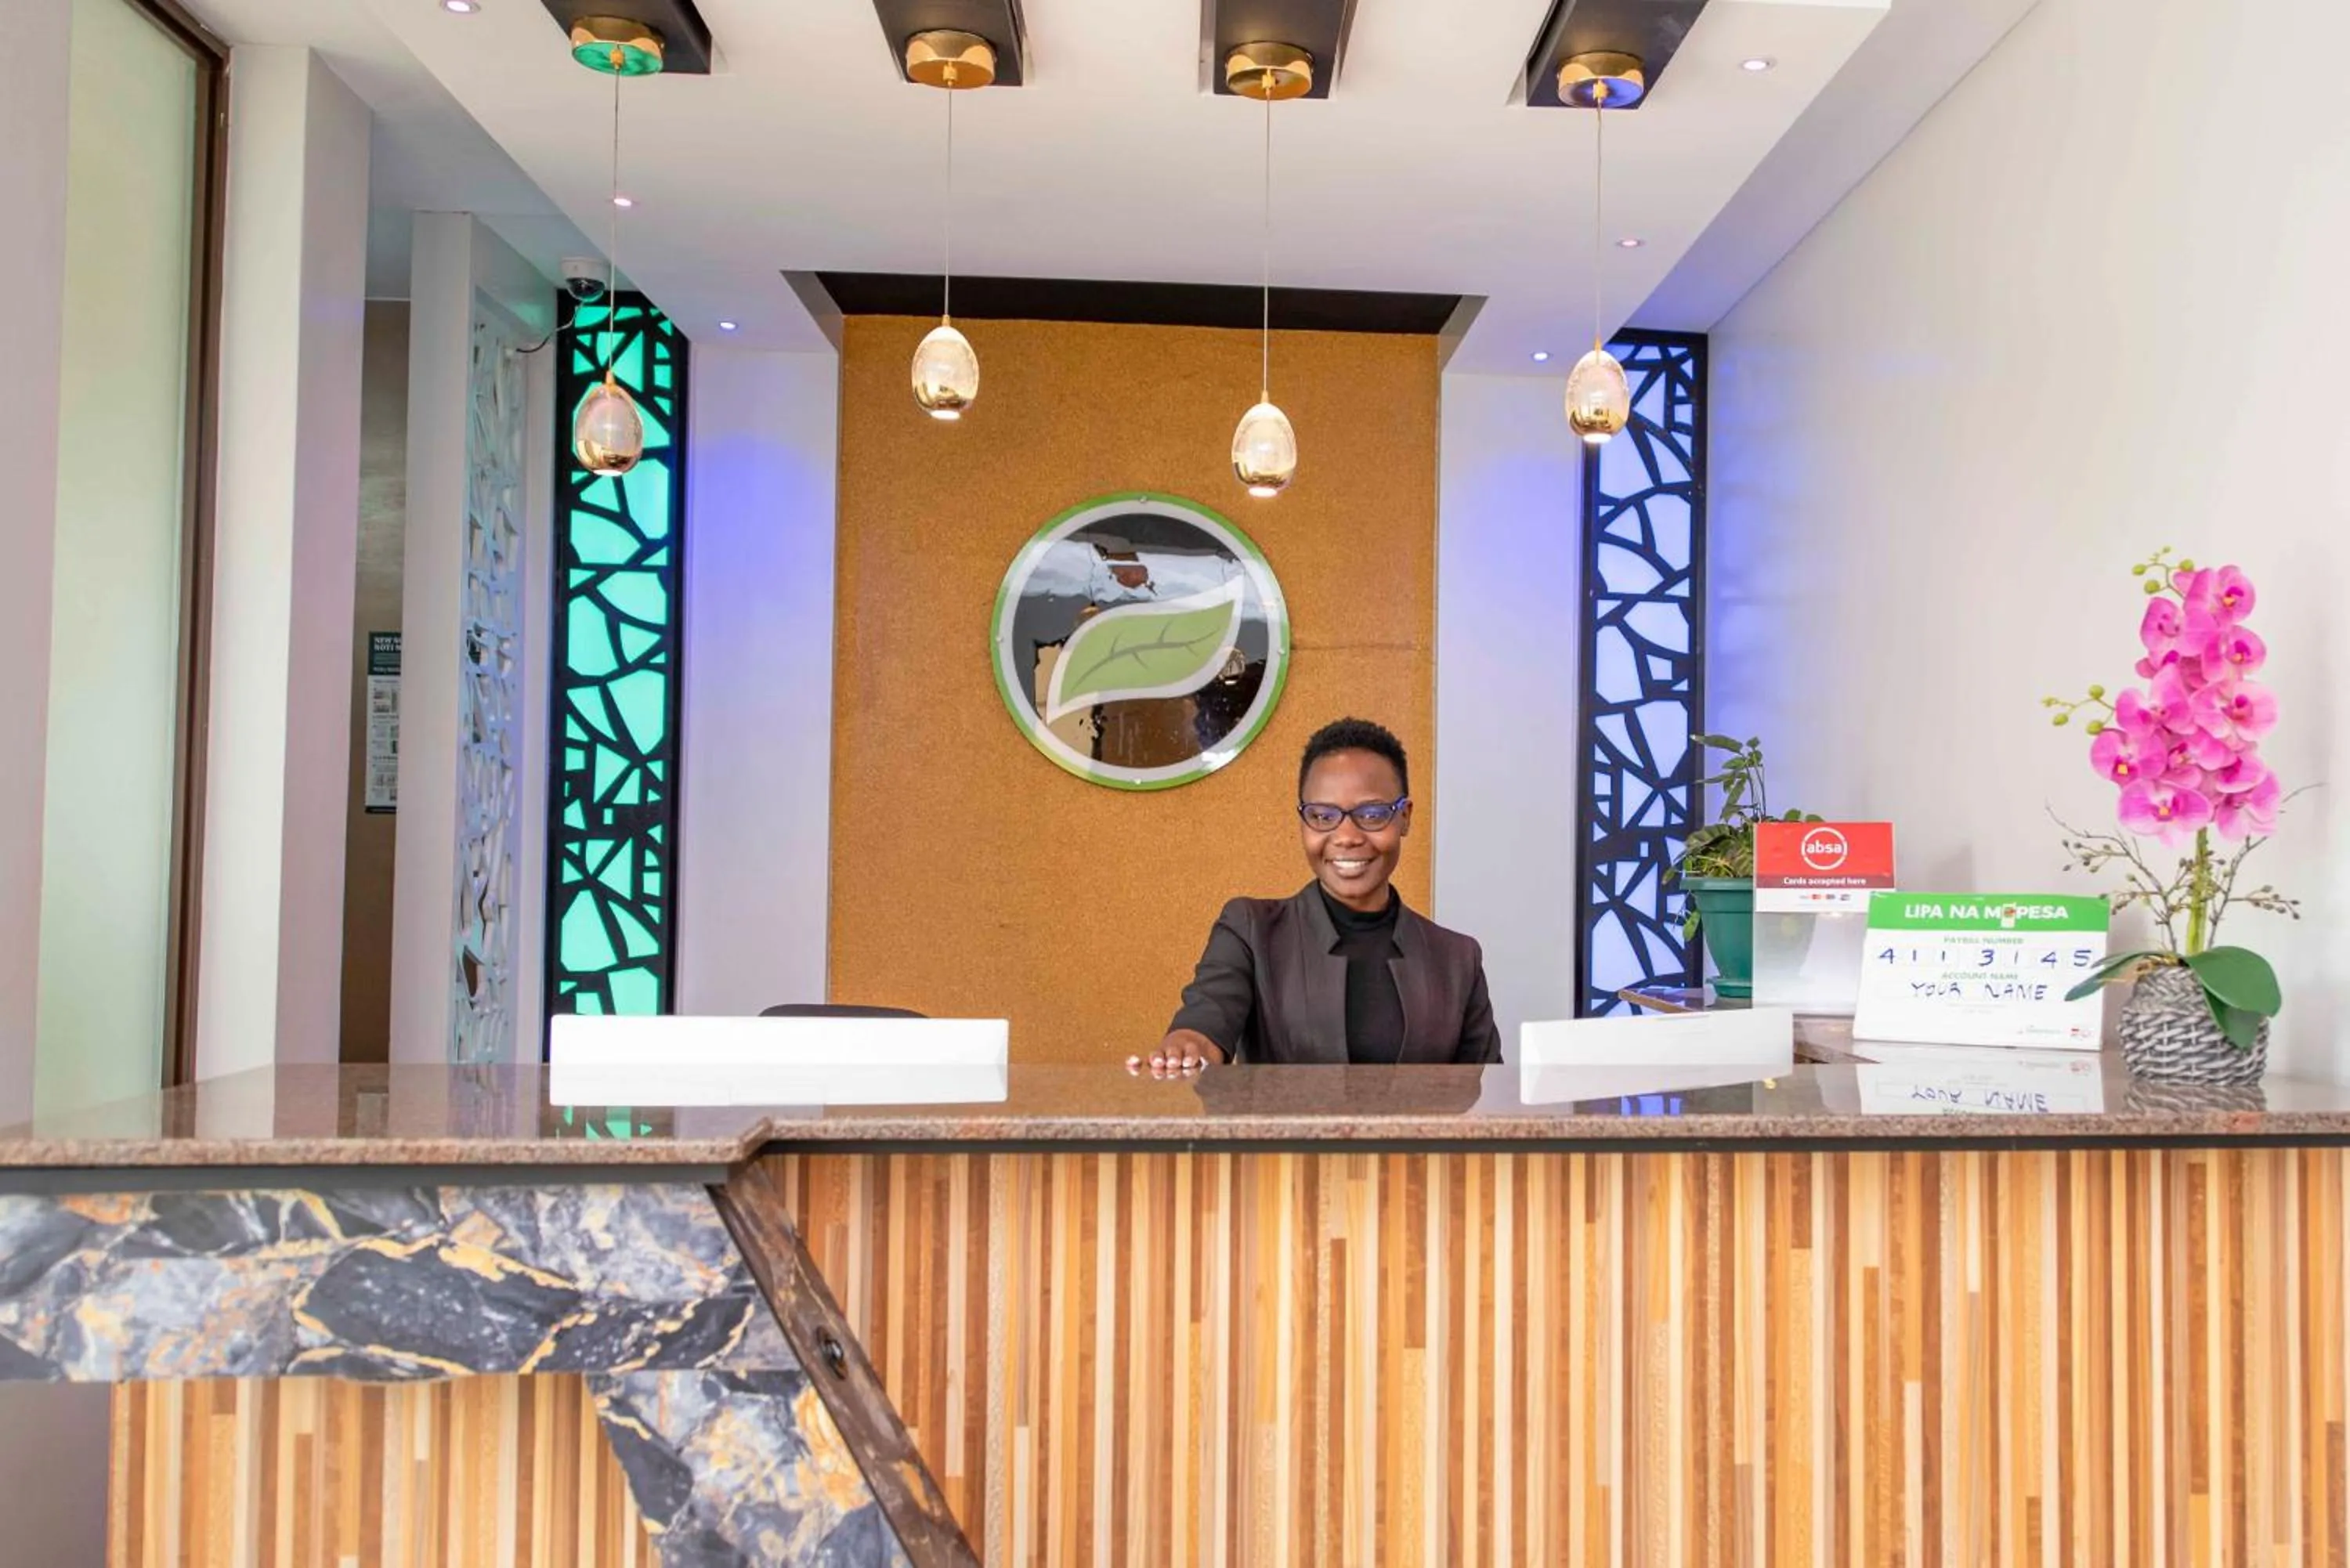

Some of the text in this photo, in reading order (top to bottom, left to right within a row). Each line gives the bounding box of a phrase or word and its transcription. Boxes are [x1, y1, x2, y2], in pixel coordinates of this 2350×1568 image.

[1806, 839, 1842, 854] absa
[1784, 876, 1867, 887] Cards accepted here
[1904, 904, 1943, 919] LIPA
[1949, 905, 1980, 920] NA
[1985, 937, 2025, 945] NUMBER
[1941, 972, 1987, 981] ACCOUNT
[1911, 981, 2048, 1001] YOUR NAME
